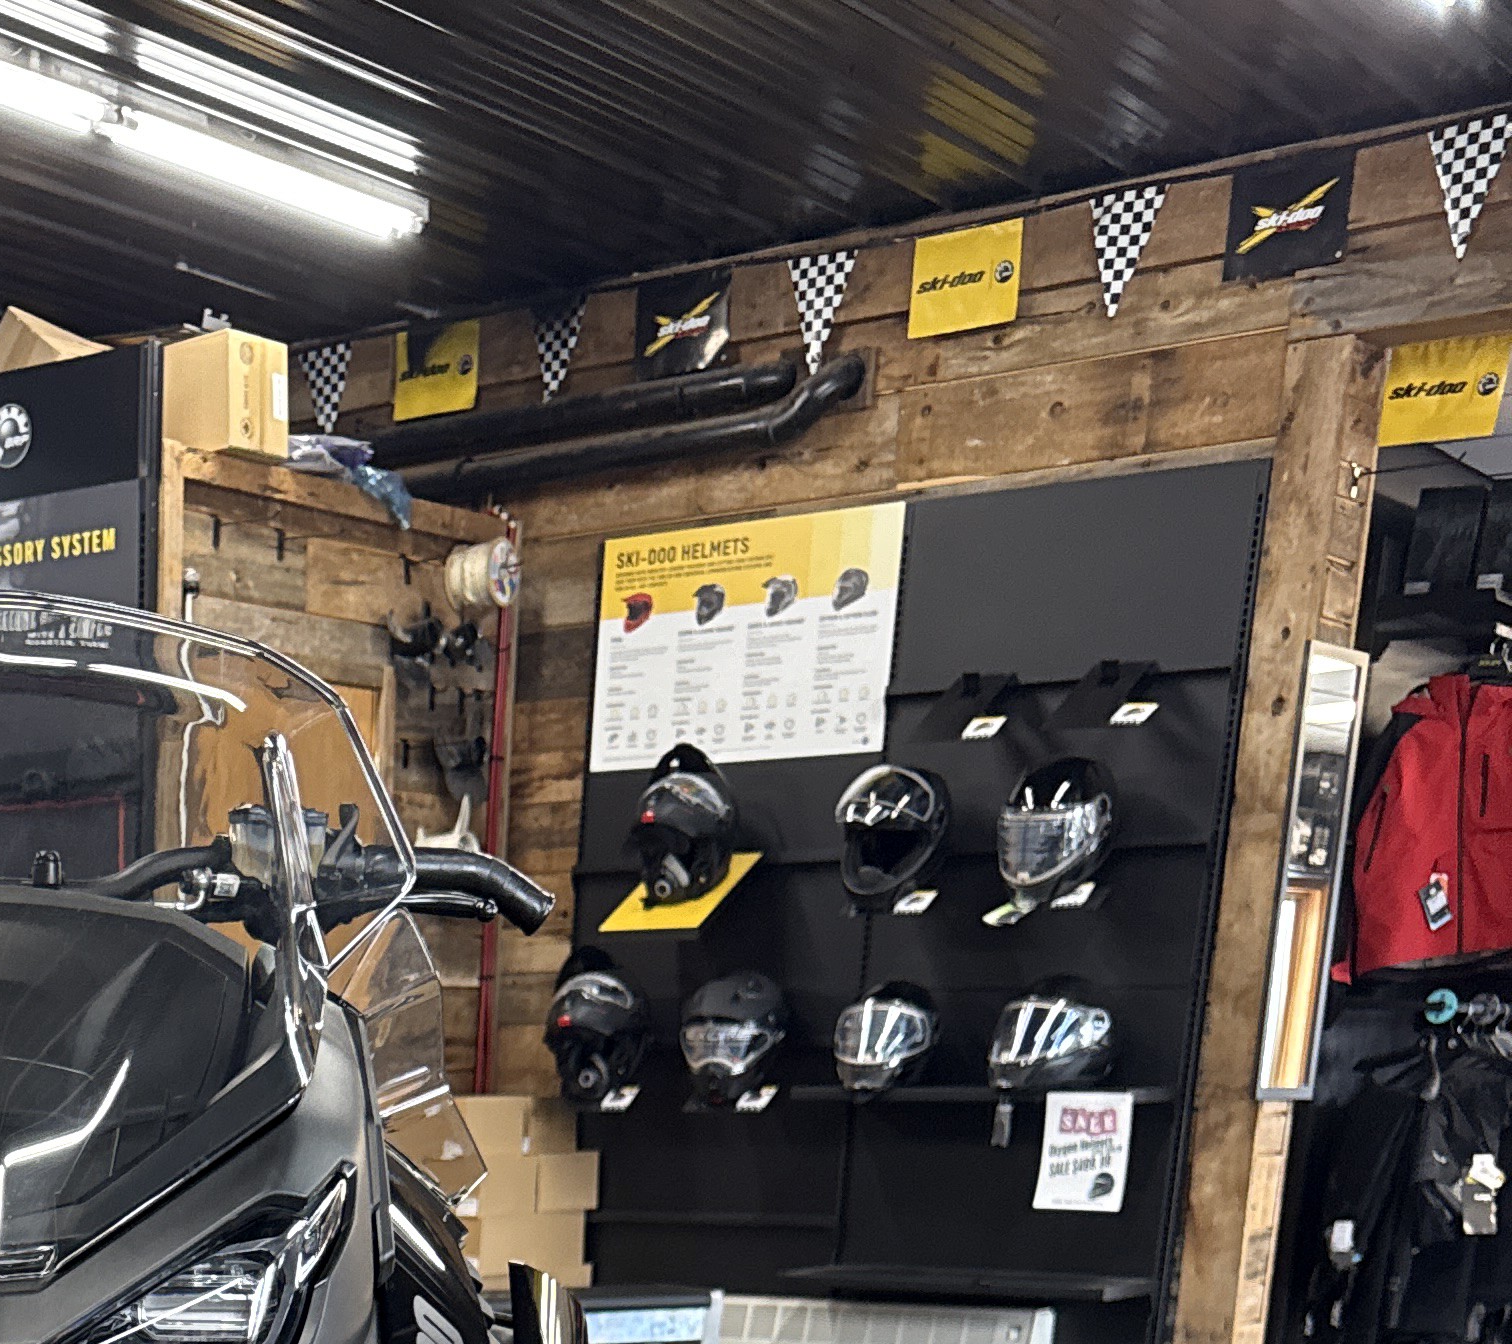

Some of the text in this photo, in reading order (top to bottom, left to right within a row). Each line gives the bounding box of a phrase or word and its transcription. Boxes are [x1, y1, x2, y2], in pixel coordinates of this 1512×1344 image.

[1254, 205, 1325, 231] ski-doo
[917, 268, 985, 295] ski-doo
[1388, 381, 1468, 400] ski-doo
[51, 527, 116, 560] SYSTEM
[616, 536, 750, 569] SKI-DOO HELMETS
